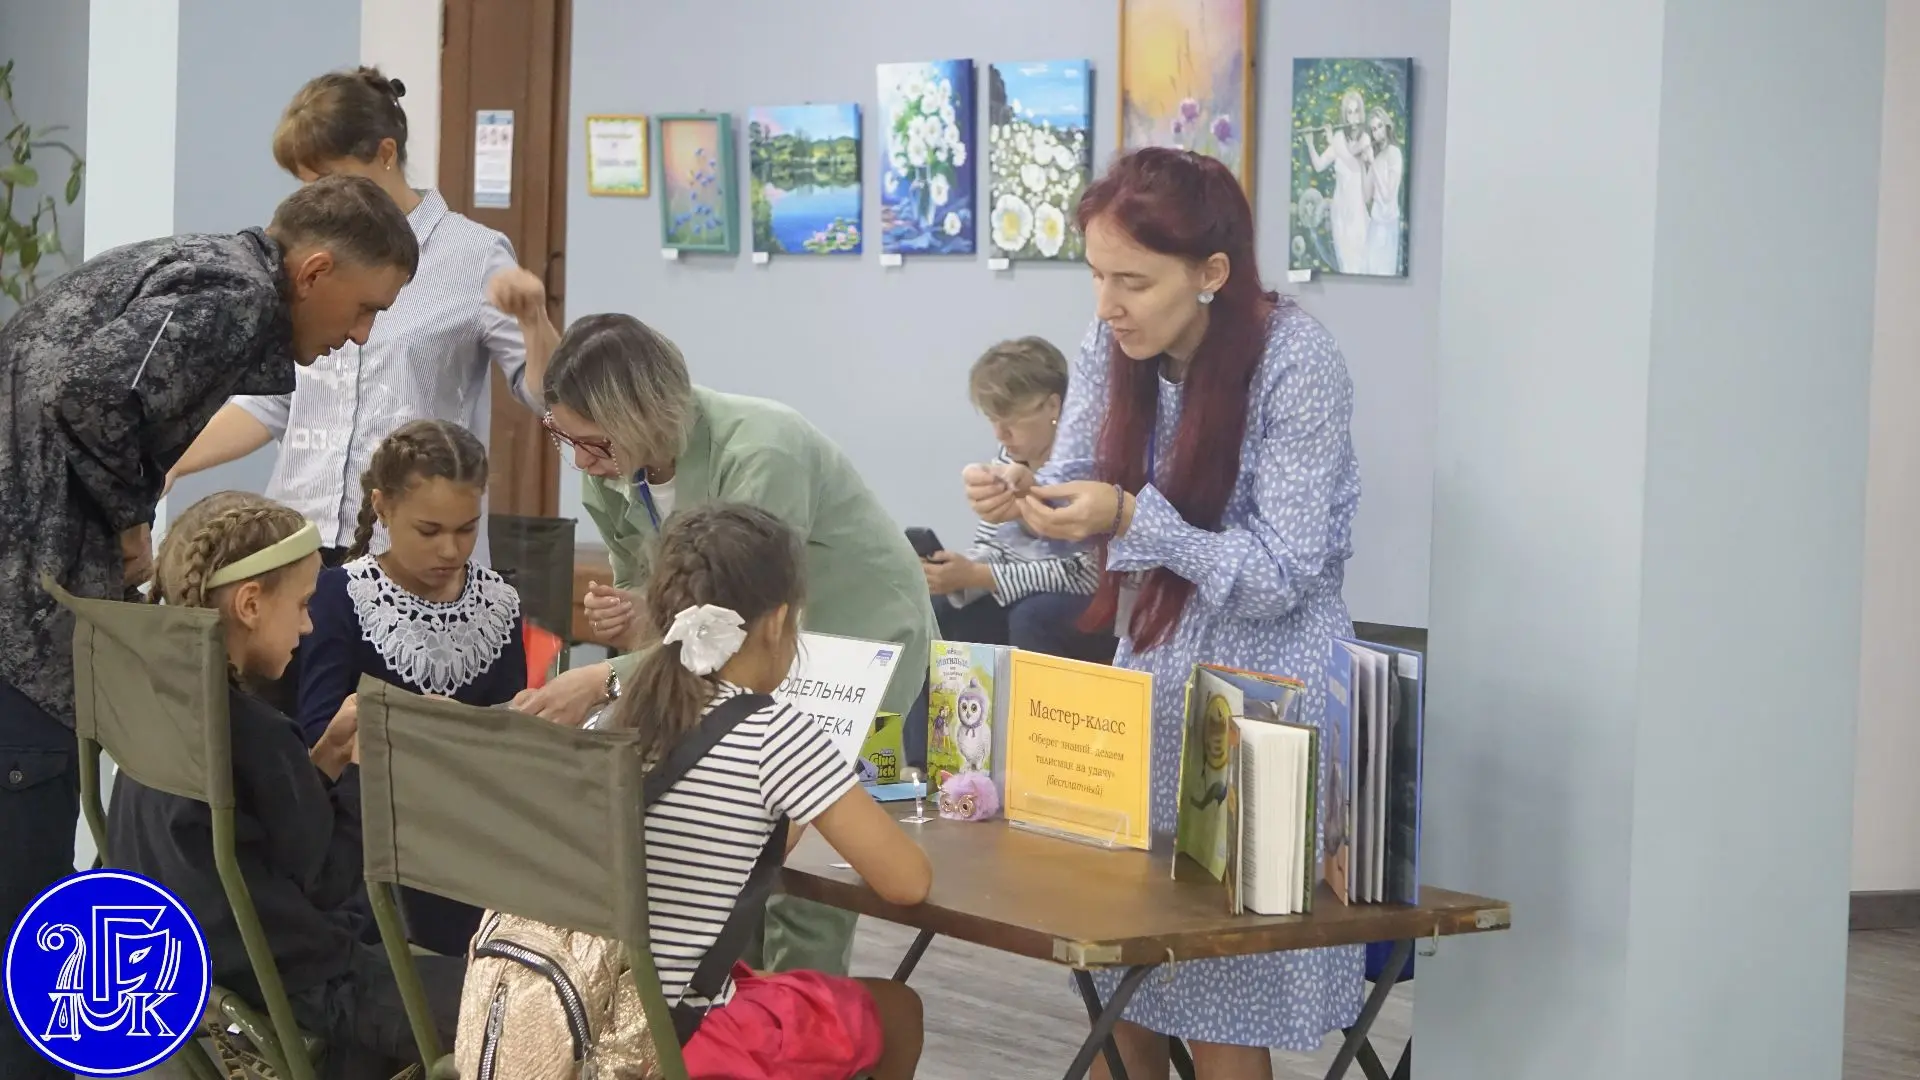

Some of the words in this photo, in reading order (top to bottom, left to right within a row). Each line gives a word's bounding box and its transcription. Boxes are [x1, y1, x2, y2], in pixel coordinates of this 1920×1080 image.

[778, 677, 866, 704] ОДЕЛЬНАЯ
[1029, 698, 1126, 735] Мастер-класс
[1036, 754, 1074, 770] талисман
[1075, 763, 1086, 773] на
[1094, 748, 1124, 761] делаем
